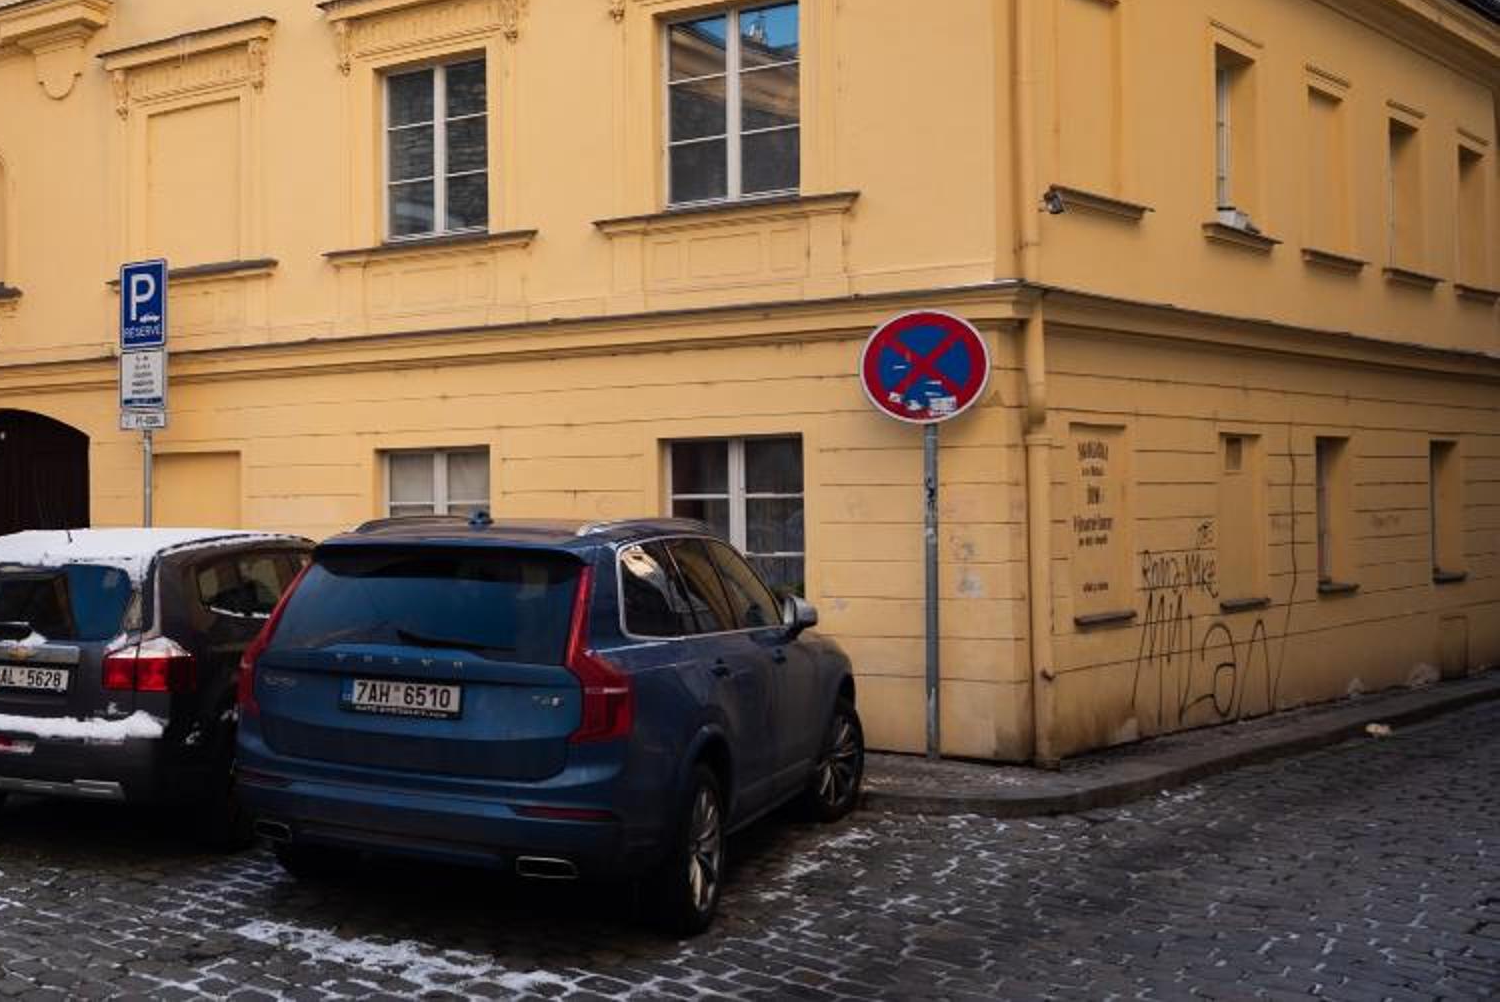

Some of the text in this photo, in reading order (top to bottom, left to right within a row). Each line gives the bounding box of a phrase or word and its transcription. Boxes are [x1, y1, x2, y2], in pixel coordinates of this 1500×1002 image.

[131, 273, 156, 321] P
[356, 681, 451, 709] 7AH 6510
